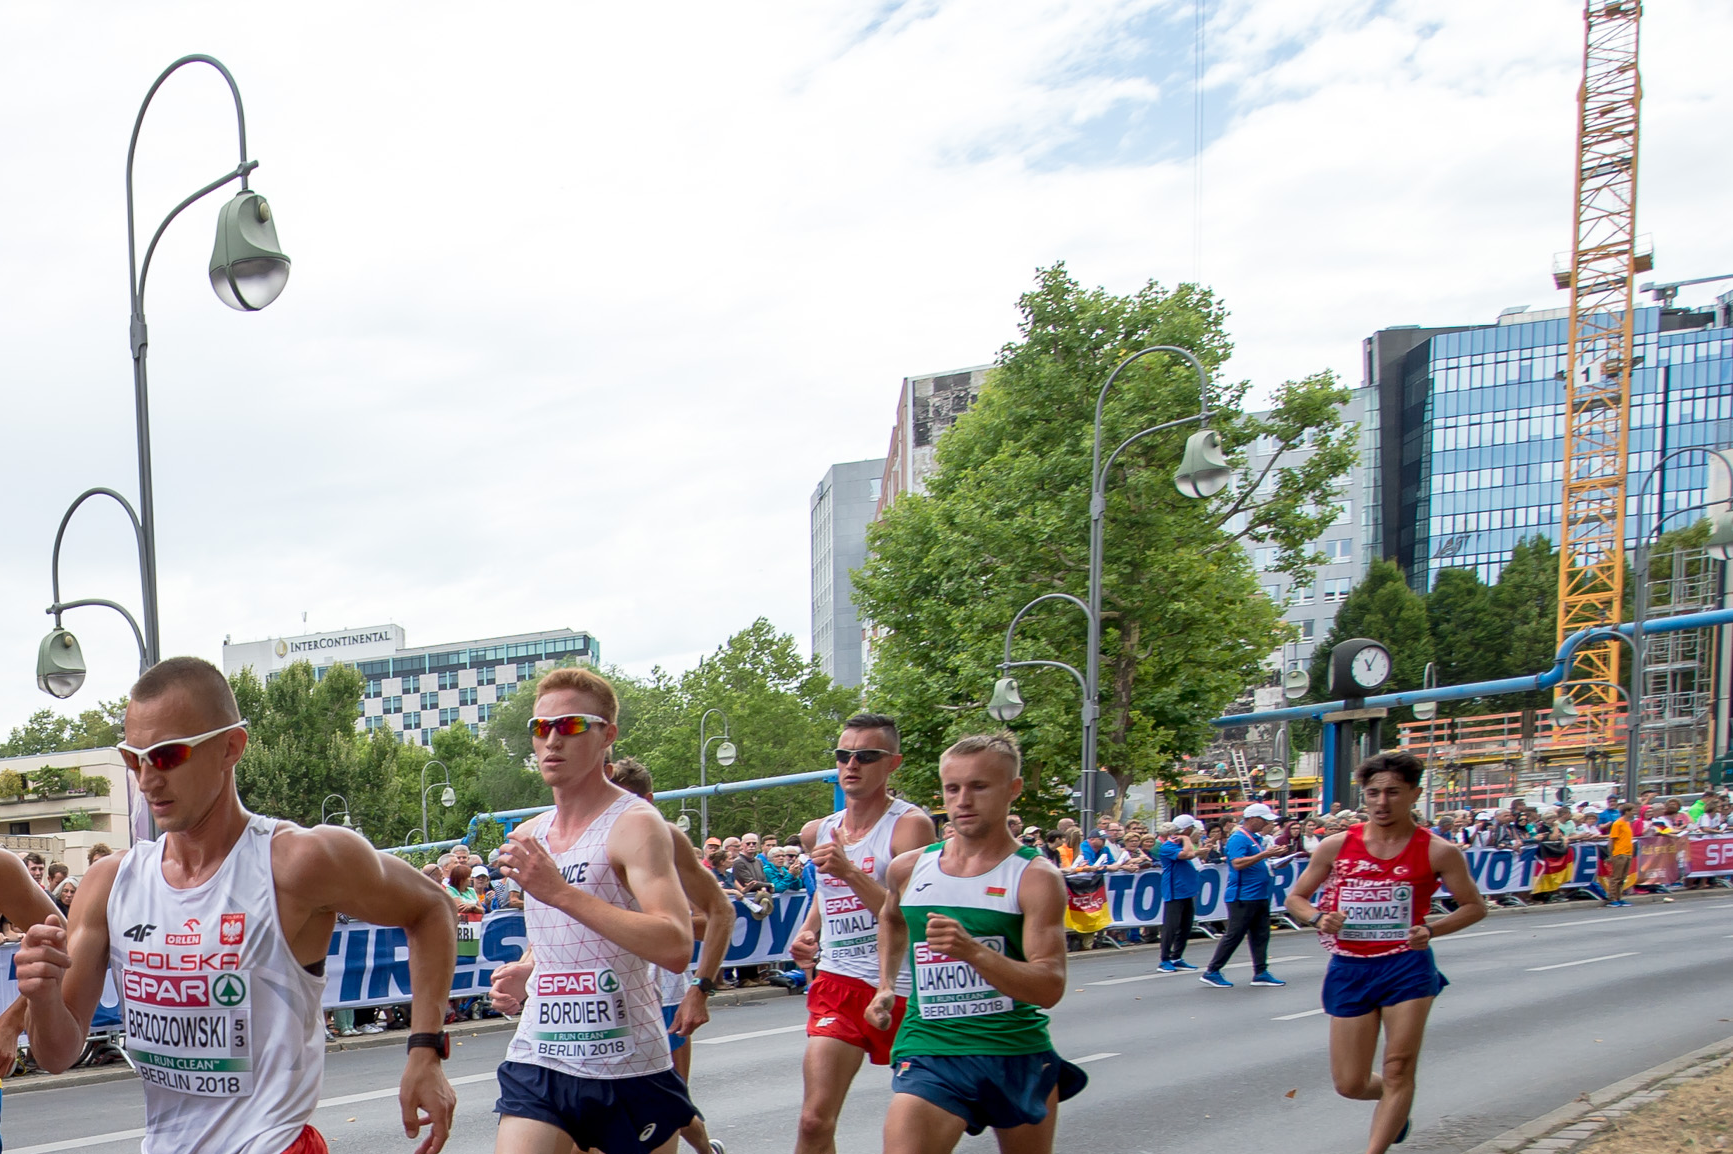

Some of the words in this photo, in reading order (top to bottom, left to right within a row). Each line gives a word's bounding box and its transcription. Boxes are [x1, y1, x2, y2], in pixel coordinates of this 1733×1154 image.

[1704, 843, 1733, 866] SP
[560, 862, 589, 884] NCE
[1341, 889, 1392, 901] SPAR
[123, 924, 157, 942] 4F
[167, 936, 199, 944] ORLEN
[1343, 931, 1377, 939] BERLIN
[1379, 930, 1405, 939] 2018
[129, 951, 240, 970] POLSKA
[832, 947, 866, 959] BERLIN
[124, 973, 207, 1003] SPAR
[539, 974, 595, 993] SPAR
[539, 1000, 612, 1024] BORDIER
[923, 1004, 967, 1018] BERLIN
[970, 1000, 1004, 1014] 2018
[128, 1008, 227, 1048] BRZOZOWSKI
[558, 1033, 576, 1041] RUN
[538, 1043, 586, 1056] BERLIN
[589, 1041, 626, 1056] 2018
[154, 1056, 174, 1068] RUN
[140, 1065, 191, 1091] BERLIN
[195, 1076, 240, 1093] 2018
